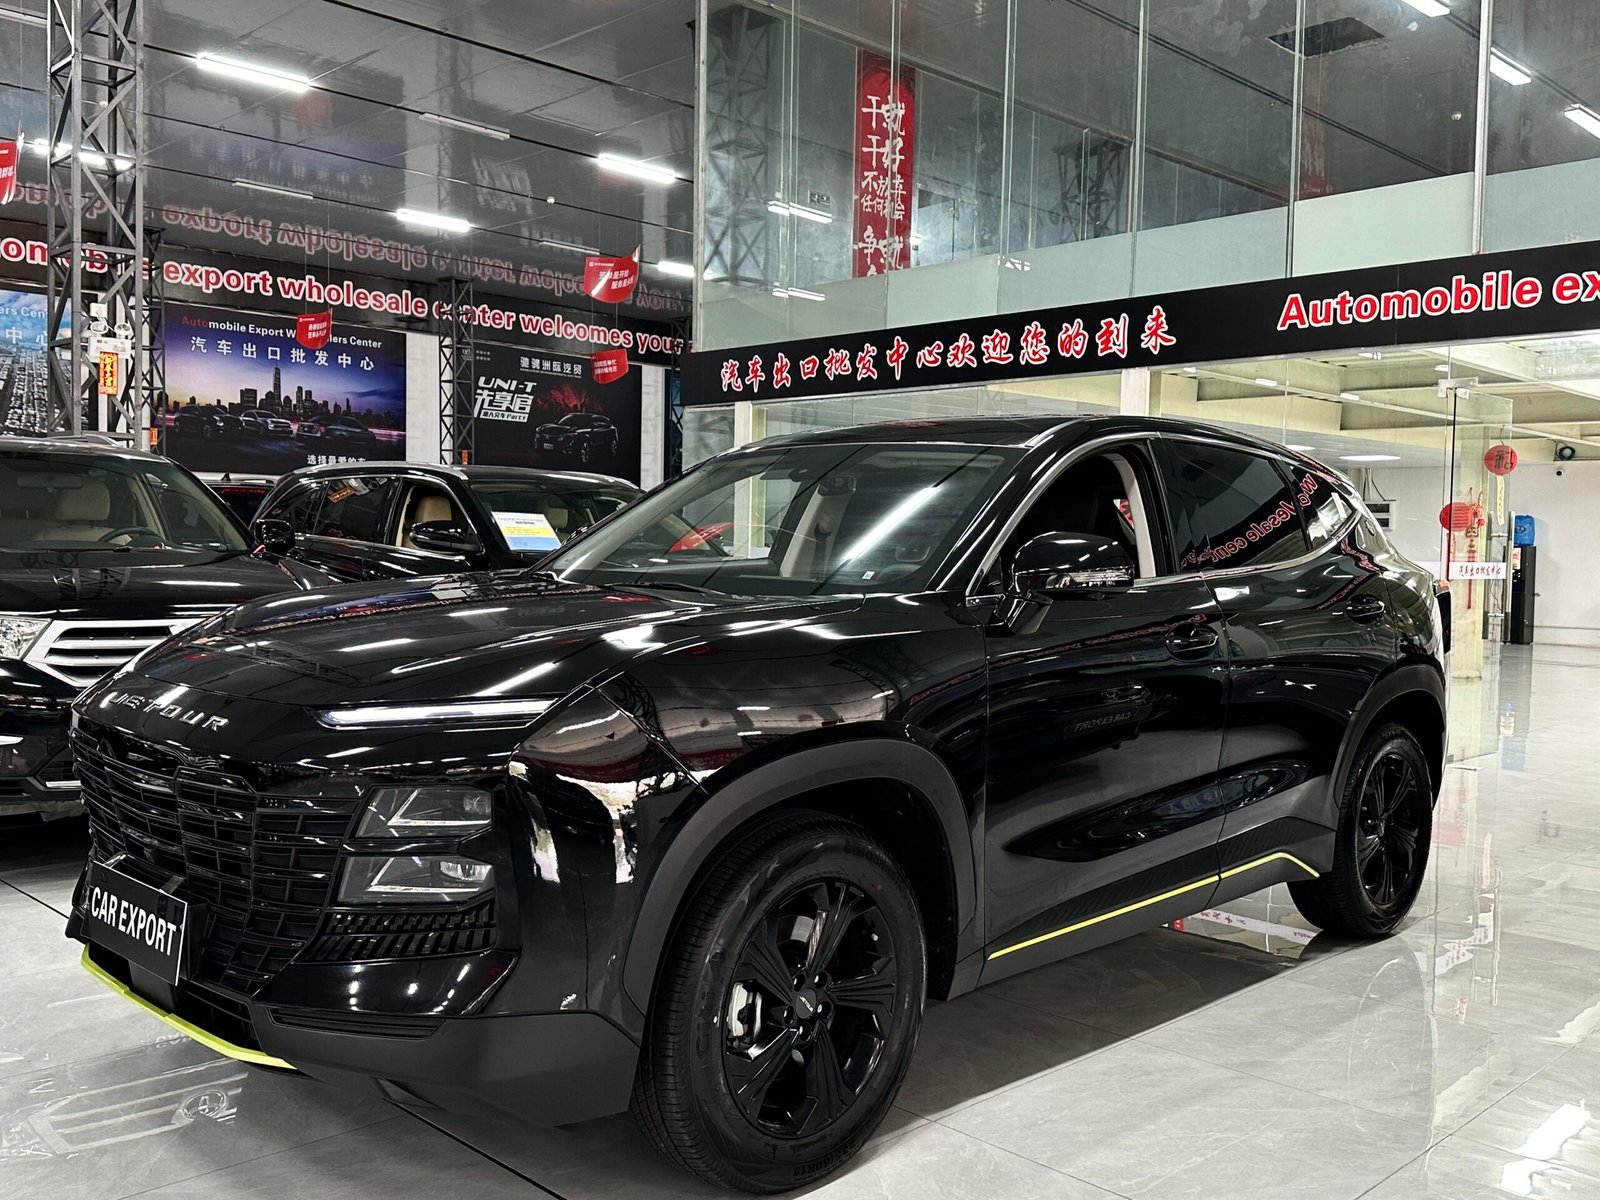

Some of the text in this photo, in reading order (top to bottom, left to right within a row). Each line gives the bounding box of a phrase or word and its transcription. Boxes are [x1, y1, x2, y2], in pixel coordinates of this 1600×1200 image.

[163, 259, 273, 296] export
[277, 274, 429, 318] wholesale
[519, 312, 633, 347] welcomes
[1277, 270, 1542, 330] Automobile
[181, 315, 246, 333] Automobile
[248, 324, 284, 338] Export
[349, 336, 382, 349] Center
[190, 336, 374, 371] 汽车出口批发中心
[721, 305, 1177, 392] 汽车出口批发中心欢迎您的到来
[478, 376, 537, 393] UNI-T
[109, 691, 229, 732] JETOUR
[91, 885, 177, 957] CAR EXPORT
